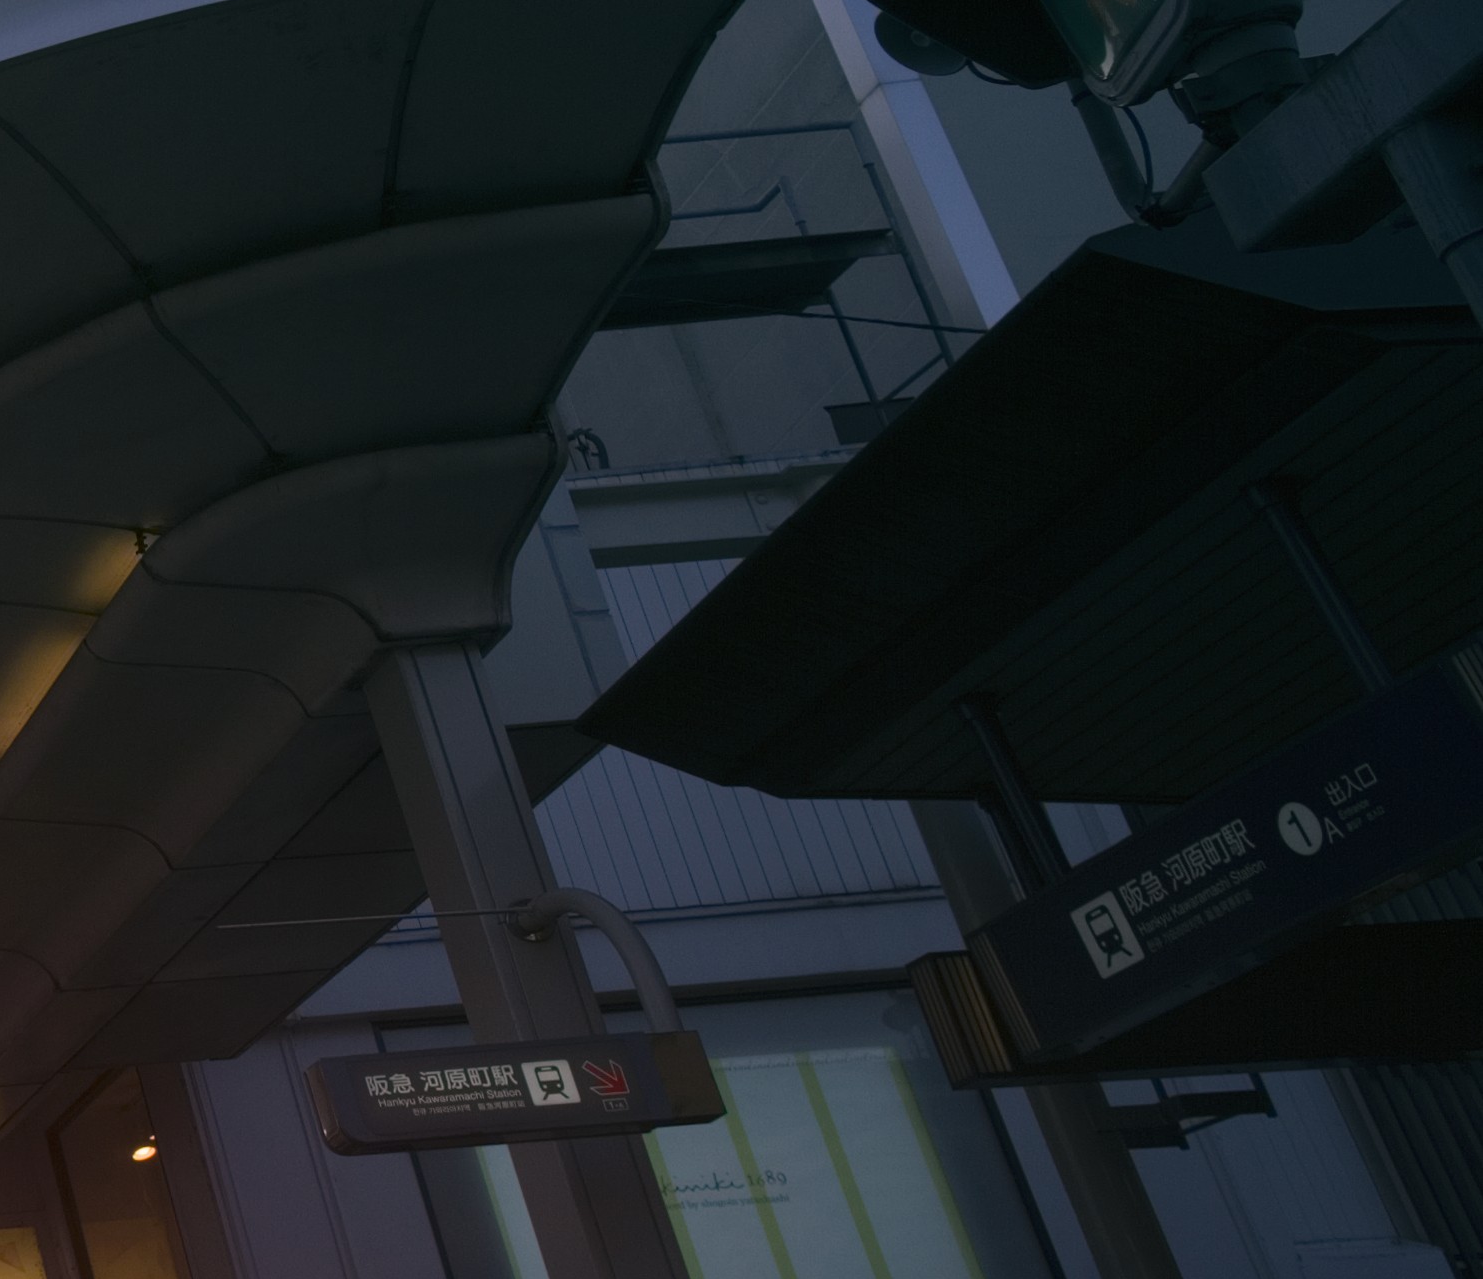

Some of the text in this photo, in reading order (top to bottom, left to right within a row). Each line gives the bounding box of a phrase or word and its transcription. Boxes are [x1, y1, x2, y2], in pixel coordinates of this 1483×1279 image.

[1324, 762, 1378, 806] 出入口
[1323, 816, 1346, 844] A
[1118, 818, 1256, 917] 阪急 河原町駅
[1229, 859, 1267, 886] Station
[365, 1064, 519, 1097] 阪急 河原町駅
[377, 1087, 522, 1109] Hankyu Kawaramachi Station
